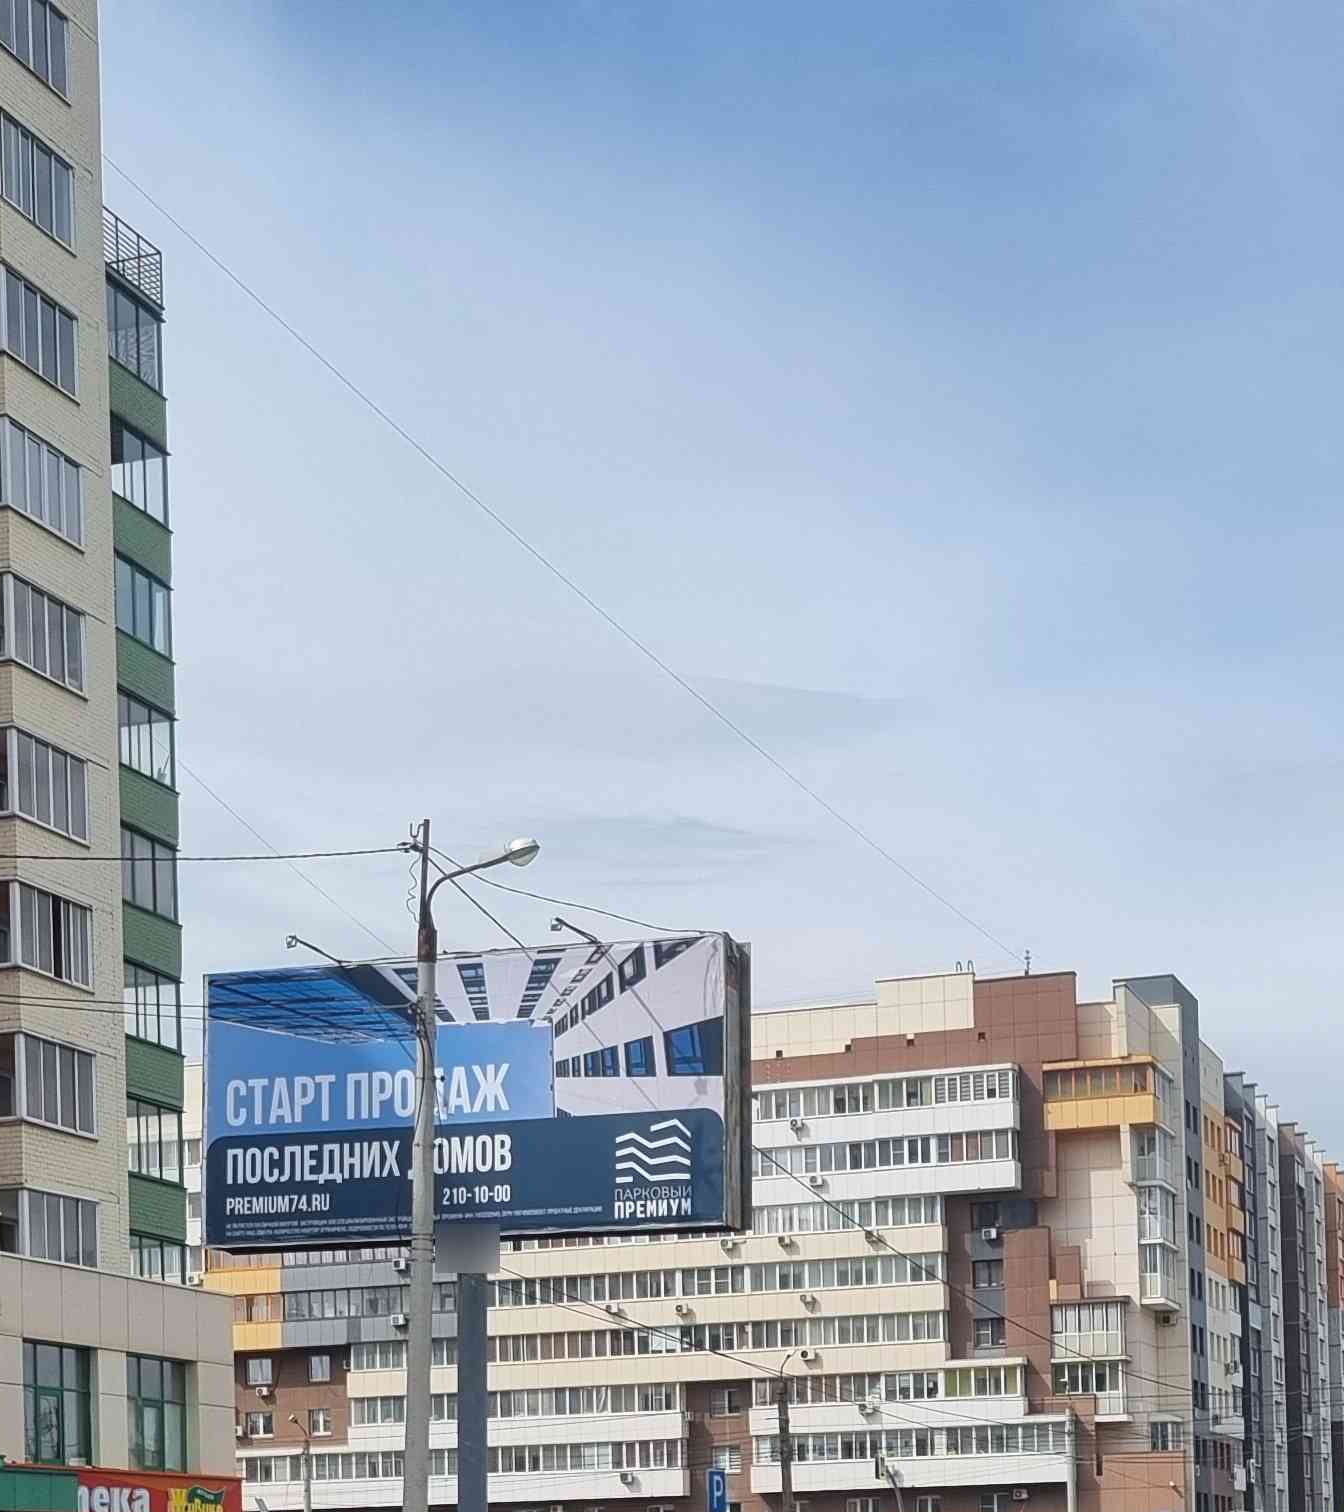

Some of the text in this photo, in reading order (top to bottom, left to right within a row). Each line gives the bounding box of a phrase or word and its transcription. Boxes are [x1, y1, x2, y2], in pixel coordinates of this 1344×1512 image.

[226, 1074, 336, 1126] СТАРТ
[226, 1133, 512, 1185] ПОСЛЕДНИХ ОМОВ
[226, 1193, 330, 1216] PREMIUM74.RU
[442, 1184, 511, 1205] 210-10-00
[614, 1198, 692, 1219] ПРЕМИУМ
